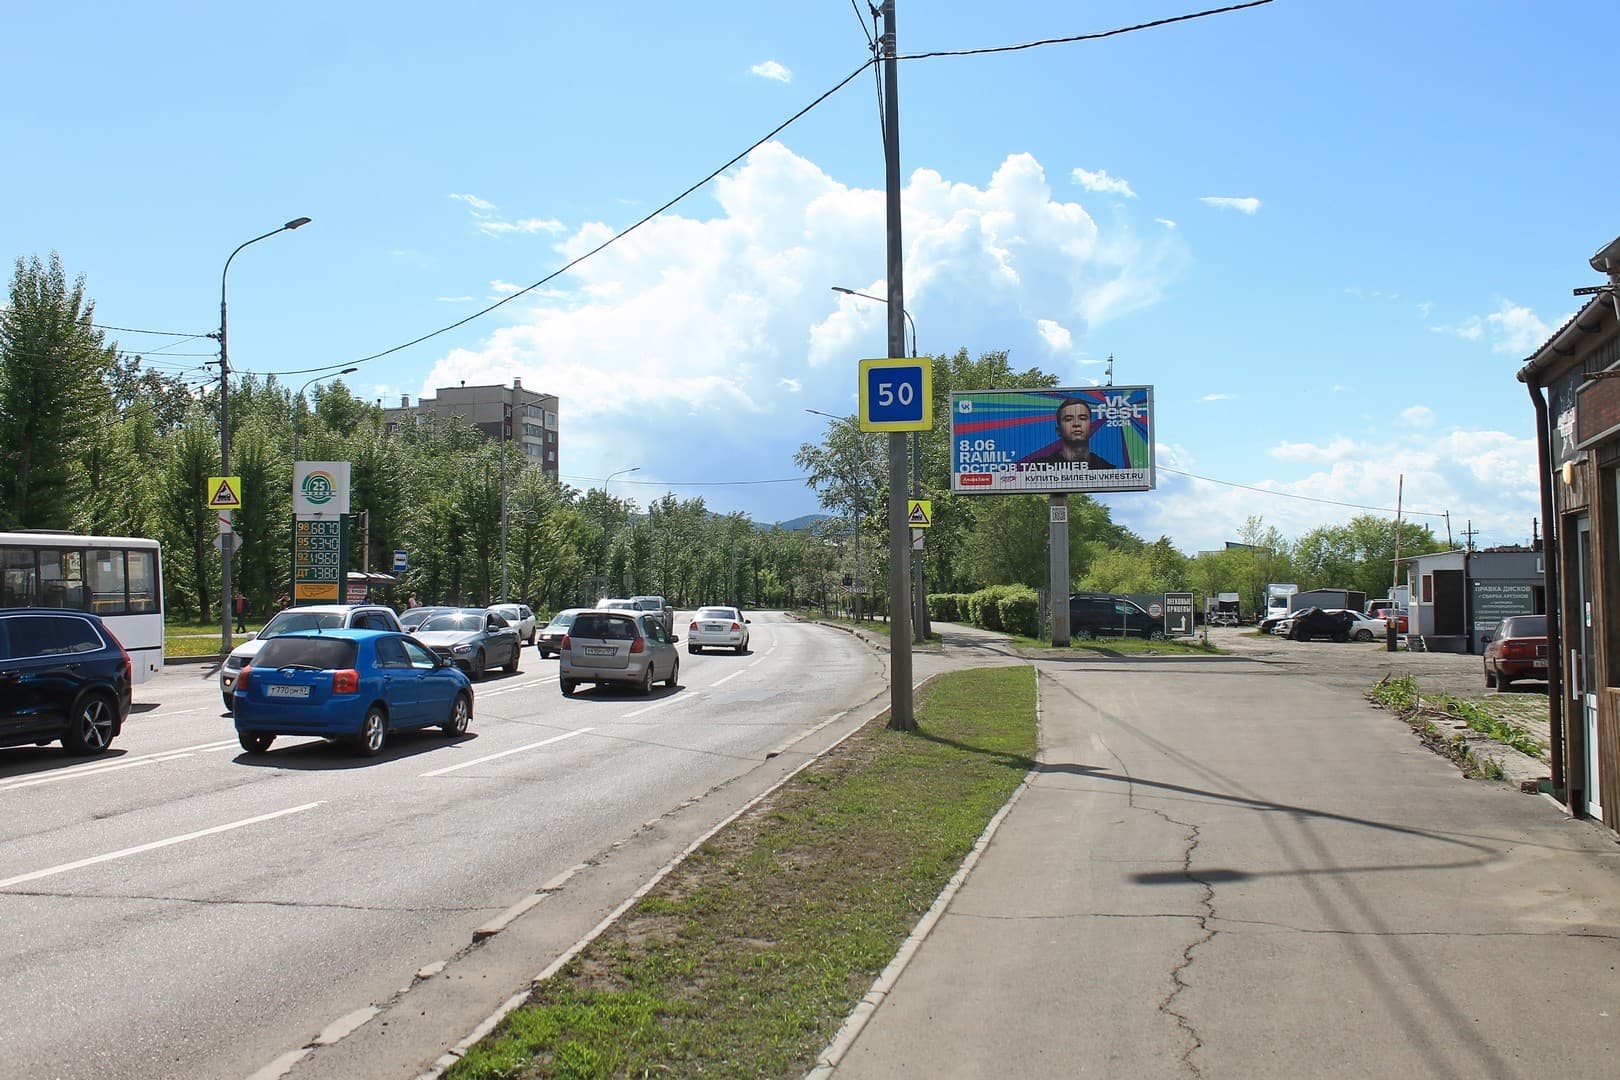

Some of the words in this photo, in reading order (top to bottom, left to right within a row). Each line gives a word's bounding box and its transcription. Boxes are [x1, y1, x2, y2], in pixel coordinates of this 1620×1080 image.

[878, 382, 914, 406] 50
[1104, 395, 1131, 407] VK
[1097, 403, 1142, 419] fest
[959, 440, 995, 451] 8.06
[959, 463, 1018, 473] ОСТРОВ
[1020, 461, 1089, 472] ТАТЫШЕВ
[1025, 474, 1059, 482] КУПИТЬ
[1061, 473, 1097, 481] БИЛЕТЫ
[1099, 472, 1144, 480] VKFEST.RU
[313, 481, 326, 491] 25
[297, 522, 310, 531] 98
[297, 538, 309, 546] 95
[297, 552, 309, 561] 92
[296, 568, 310, 578] ДТ
